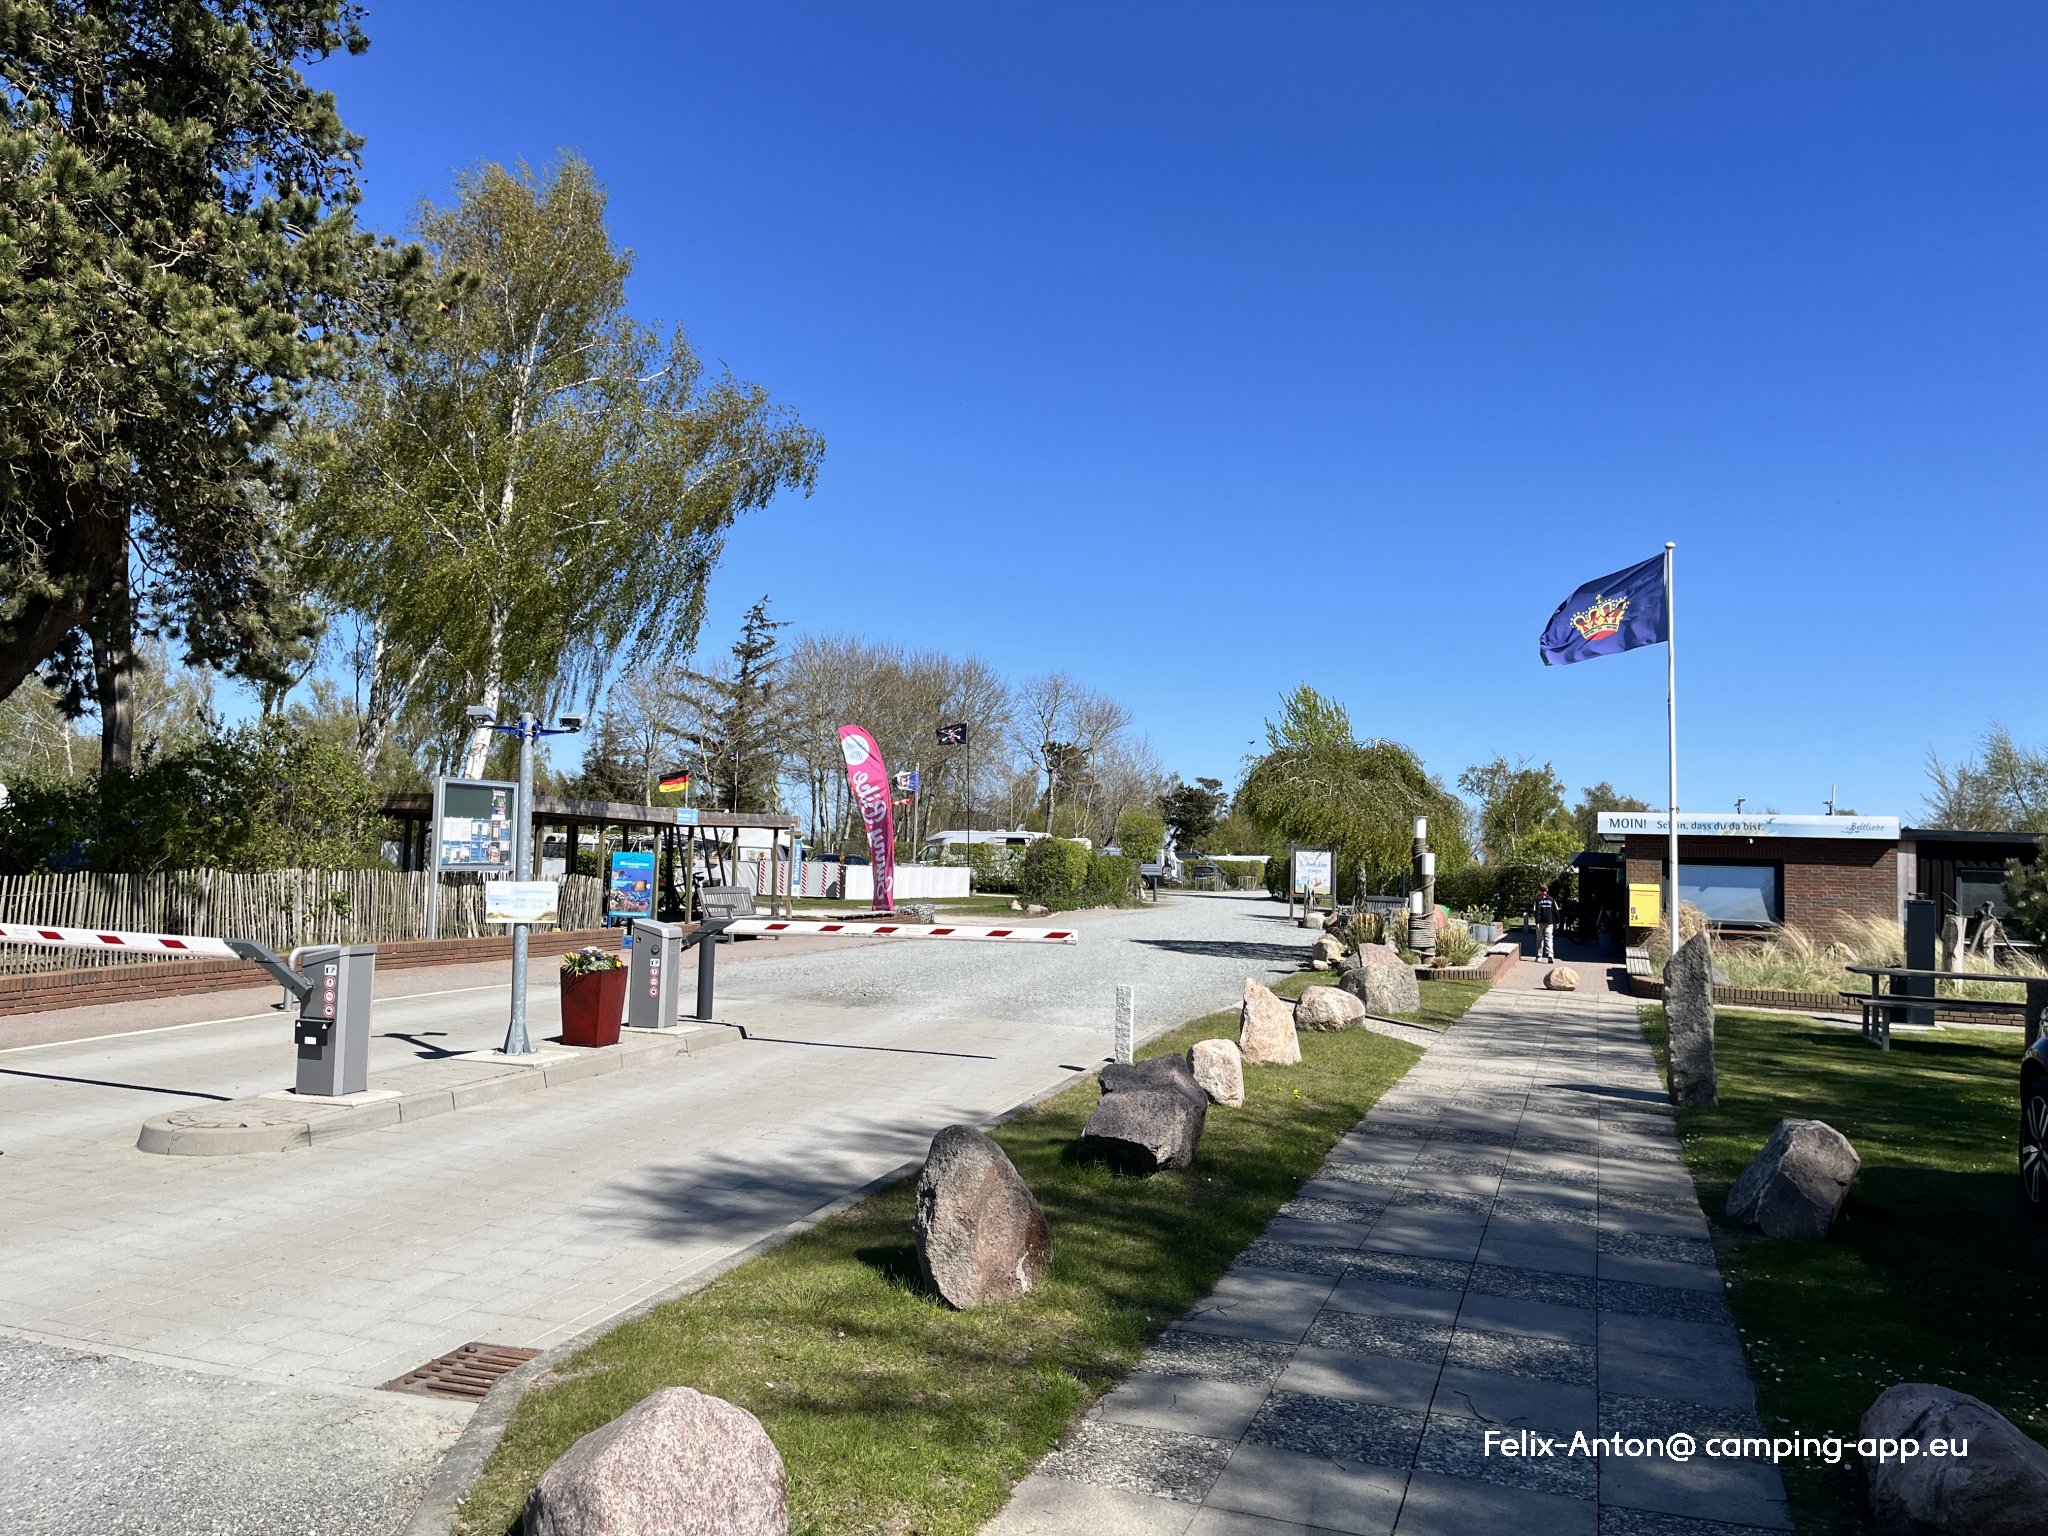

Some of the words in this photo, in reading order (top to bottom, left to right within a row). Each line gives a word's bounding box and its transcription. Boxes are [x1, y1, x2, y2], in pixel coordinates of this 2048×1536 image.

[1609, 818, 1647, 829] MOIN!
[1656, 820, 1688, 830] Scn,
[1691, 820, 1711, 830] dass
[1714, 821, 1726, 830] du
[1729, 822, 1741, 831] da
